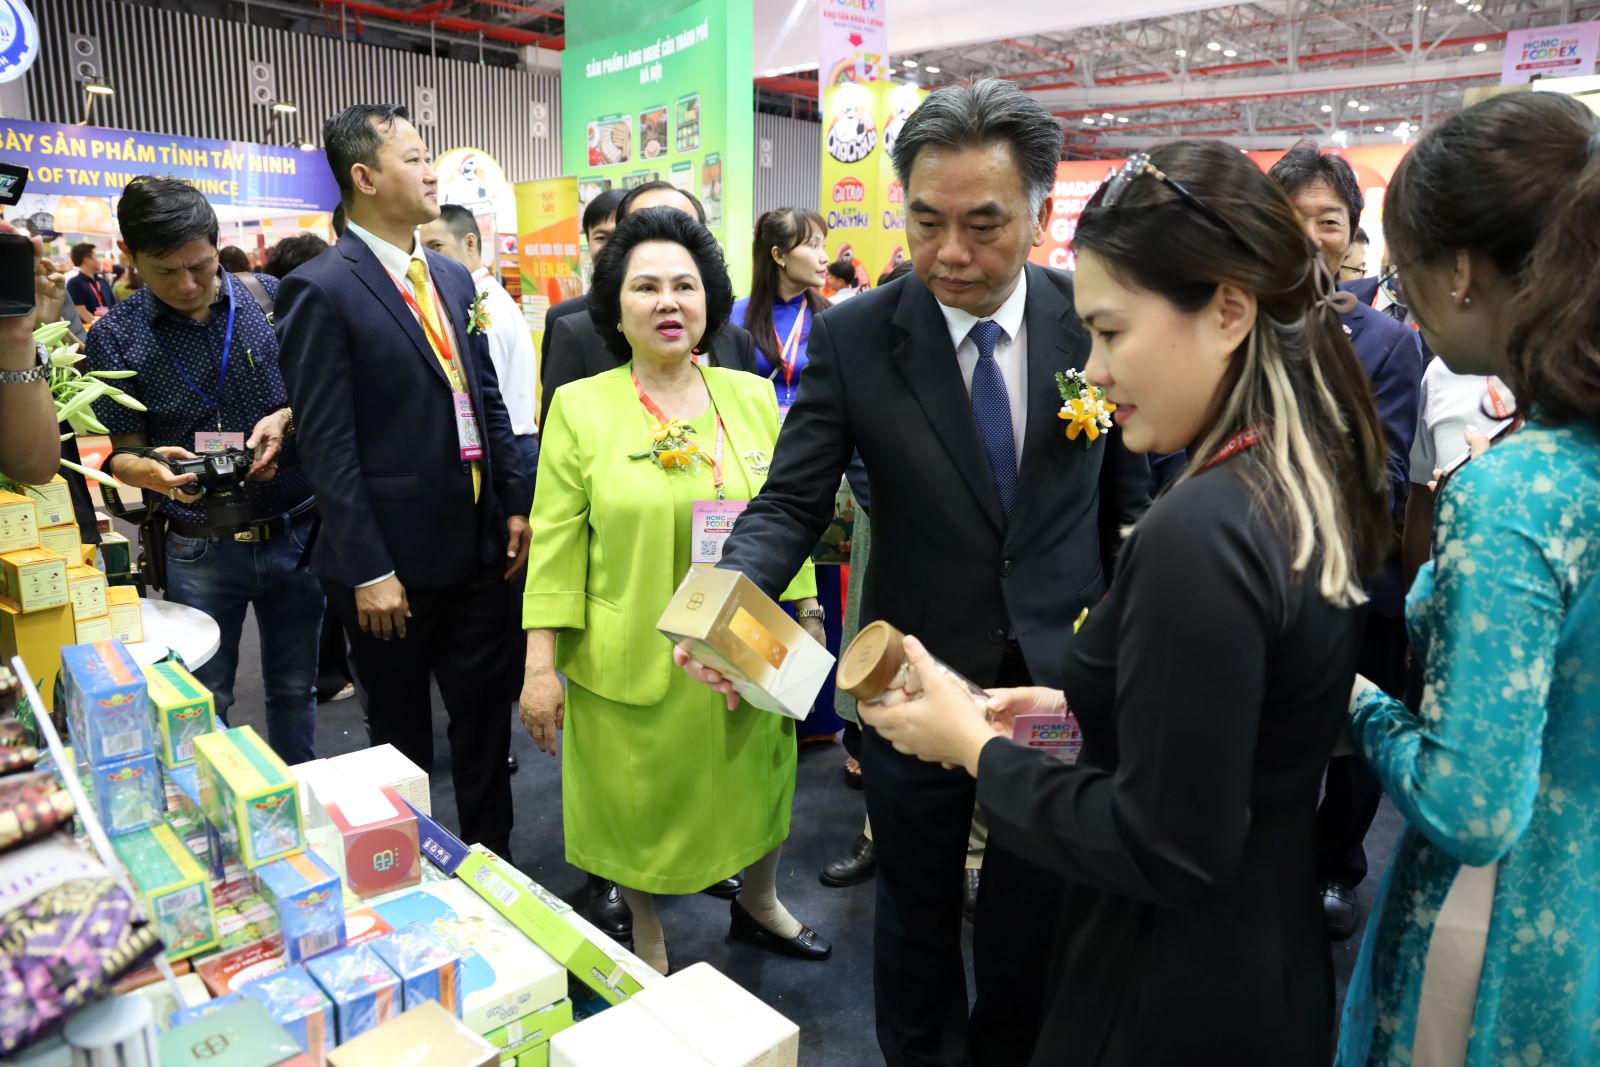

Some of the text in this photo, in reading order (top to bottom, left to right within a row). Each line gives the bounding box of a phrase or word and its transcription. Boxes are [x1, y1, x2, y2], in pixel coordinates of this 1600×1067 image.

[1523, 38, 1559, 50] HCMC
[39, 130, 87, 157] SẢN
[91, 136, 156, 164] PHẨM
[159, 142, 208, 168] TỈNH
[210, 149, 245, 171] TÂY
[250, 155, 296, 176] NINH
[37, 166, 63, 184] OF
[66, 168, 100, 187] TAY
[1032, 723, 1071, 731] HCMC
[1031, 730, 1080, 740] FOODE
